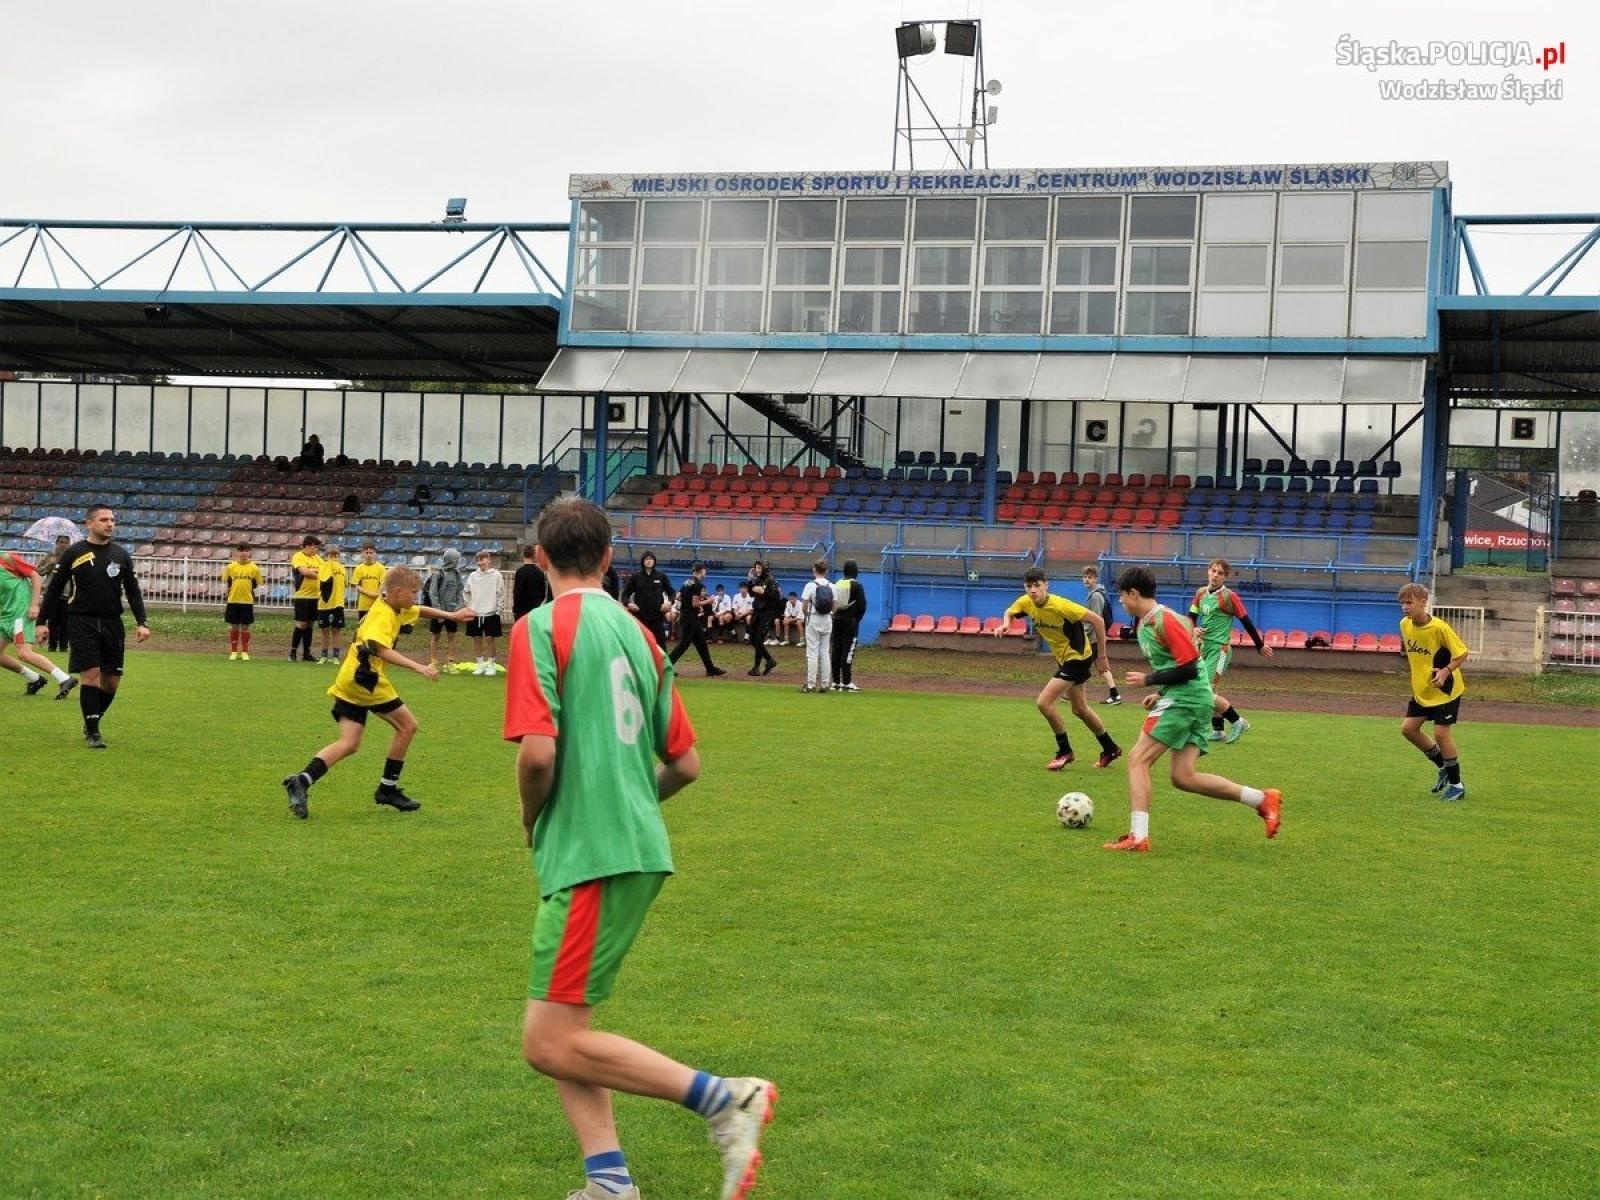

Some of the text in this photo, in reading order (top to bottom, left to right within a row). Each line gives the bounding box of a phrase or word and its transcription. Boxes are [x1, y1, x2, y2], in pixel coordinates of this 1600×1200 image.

[632, 178, 708, 193] MIEJSKI
[811, 175, 889, 191] SPORTU
[908, 174, 1021, 190] REKREACJI
[1154, 169, 1283, 187] WODZISŁAW
[1289, 166, 1371, 188] ŚLĄSKI
[1086, 421, 1106, 441] C
[1514, 418, 1534, 438] B
[610, 655, 644, 745] 6
